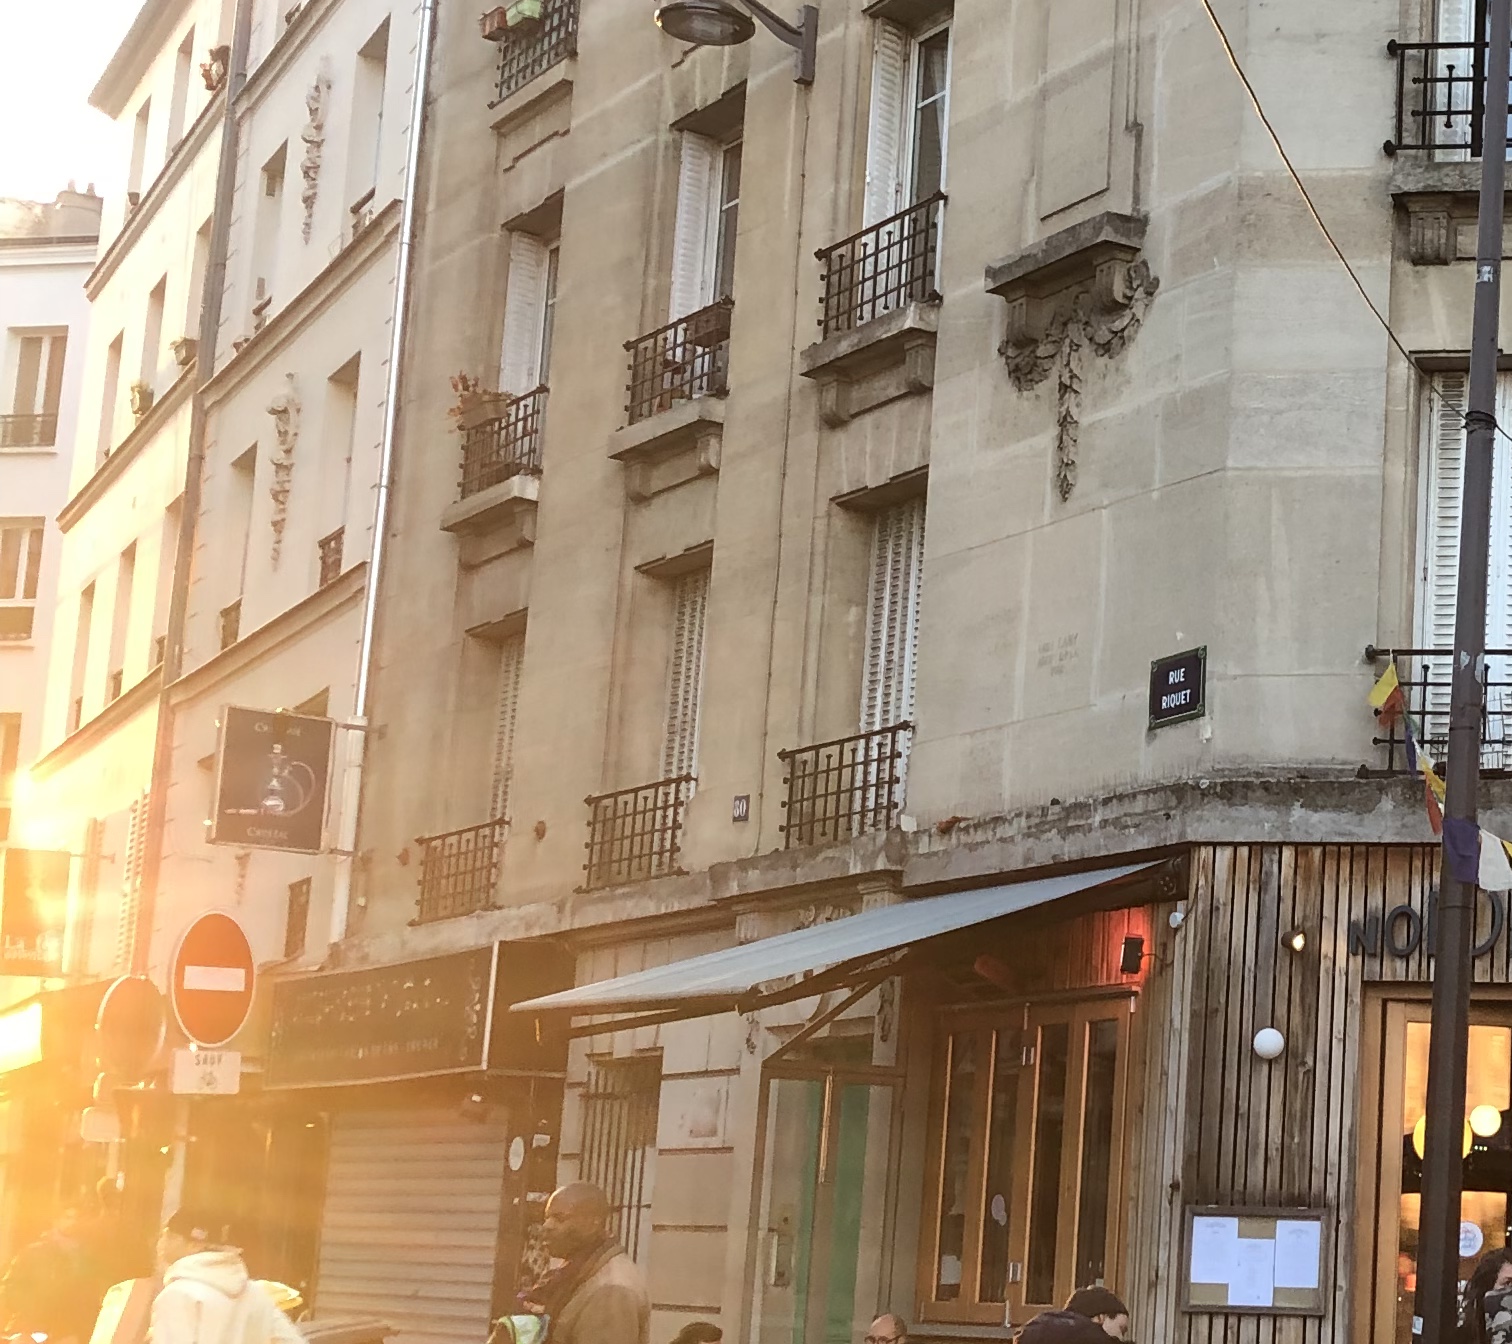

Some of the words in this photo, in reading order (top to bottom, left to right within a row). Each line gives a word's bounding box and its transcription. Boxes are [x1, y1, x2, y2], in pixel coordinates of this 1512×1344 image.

[1168, 667, 1186, 685] RUE
[1161, 689, 1192, 710] RIQUET
[733, 799, 747, 818] 80
